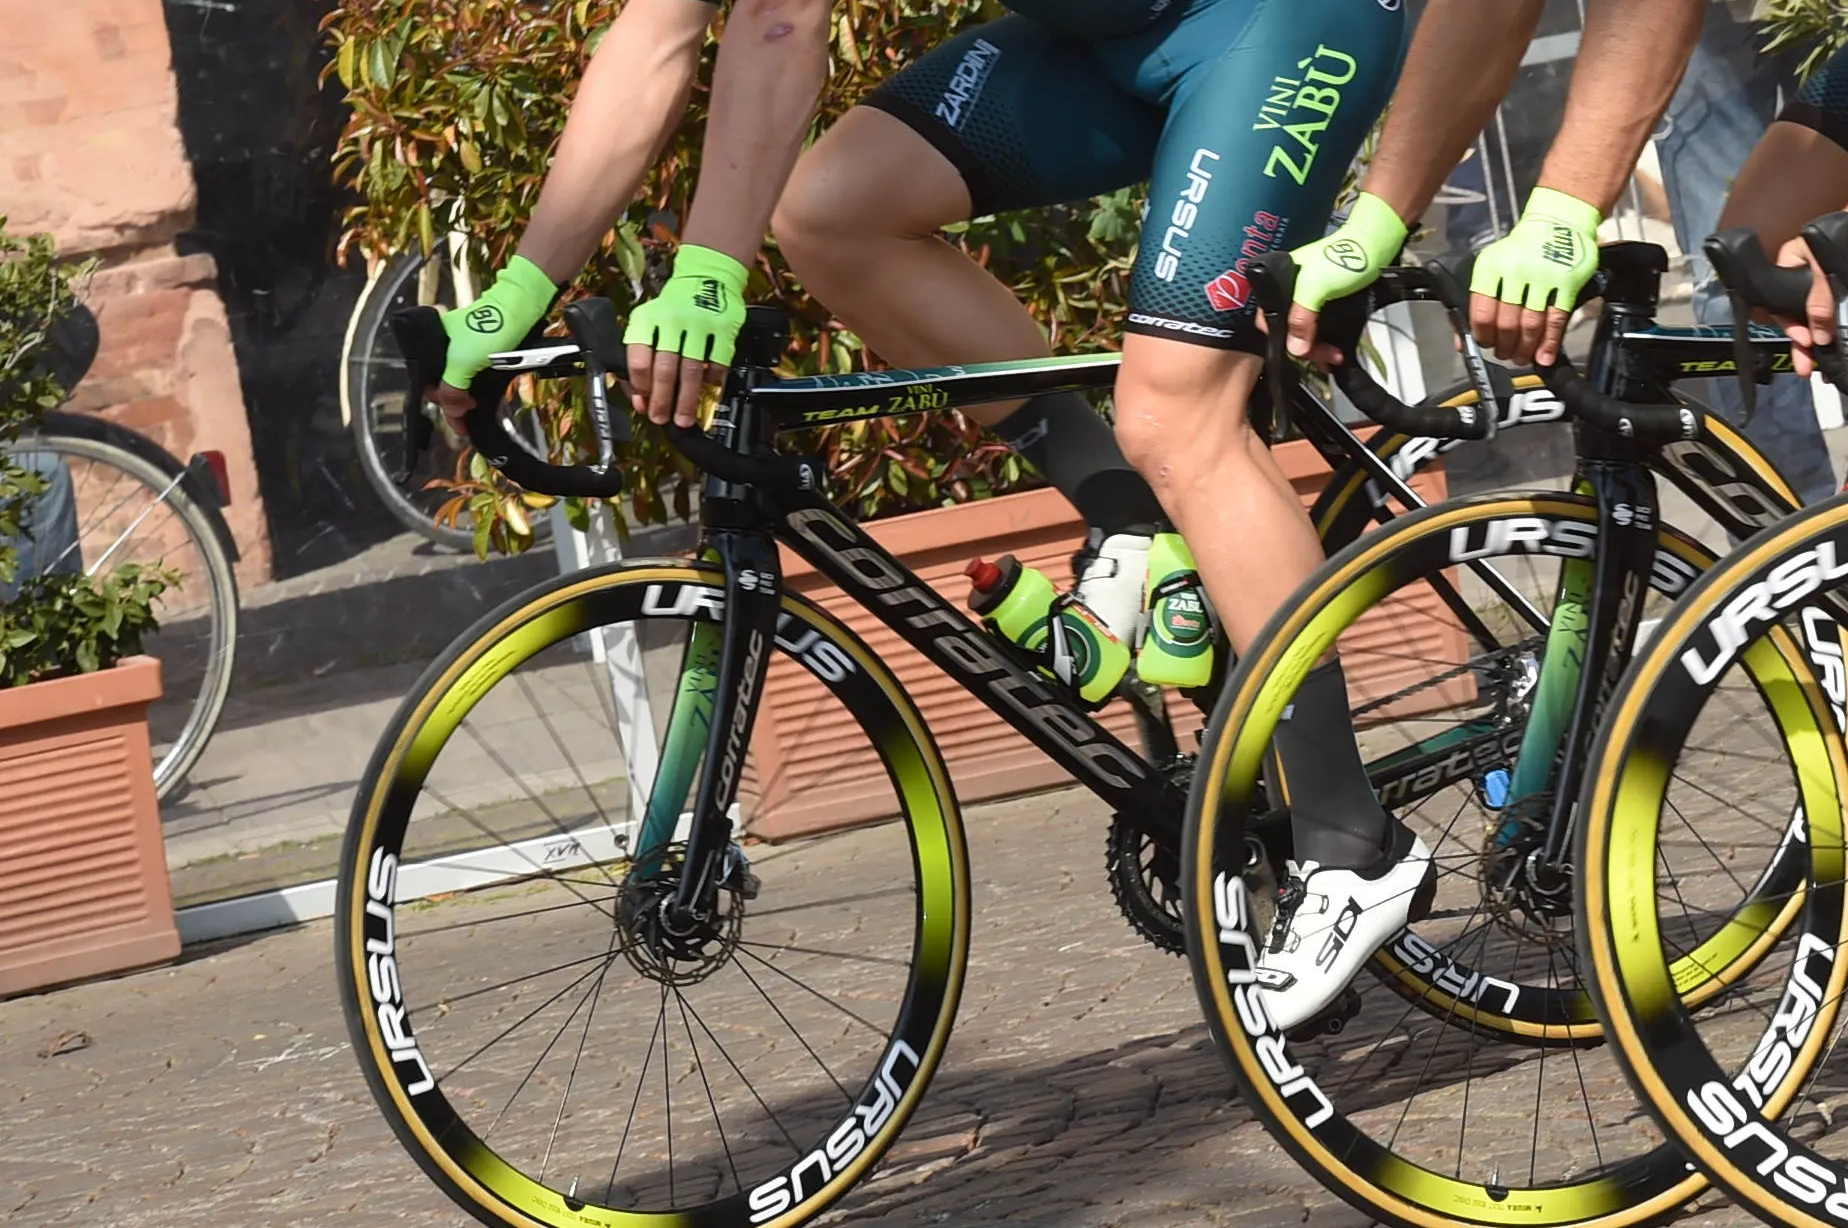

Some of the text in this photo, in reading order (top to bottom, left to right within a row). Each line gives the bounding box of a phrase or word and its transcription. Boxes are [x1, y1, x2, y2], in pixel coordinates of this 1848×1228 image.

[935, 38, 1001, 126] ZARDINI
[1252, 76, 1298, 133] VINI
[1263, 43, 1358, 185] ZABÙ
[1154, 148, 1220, 283] URSUS
[1128, 312, 1236, 339] corratec
[1680, 359, 1736, 372] TEA
[803, 388, 948, 421] TEAM ZABÙ
[785, 508, 1146, 789] corratec
[716, 629, 763, 812] corratec
[370, 846, 436, 1097] URSUS
[1215, 872, 1335, 1129] URSUS
[1316, 896, 1364, 975] SIDI
[749, 1039, 921, 1227] URSUS
